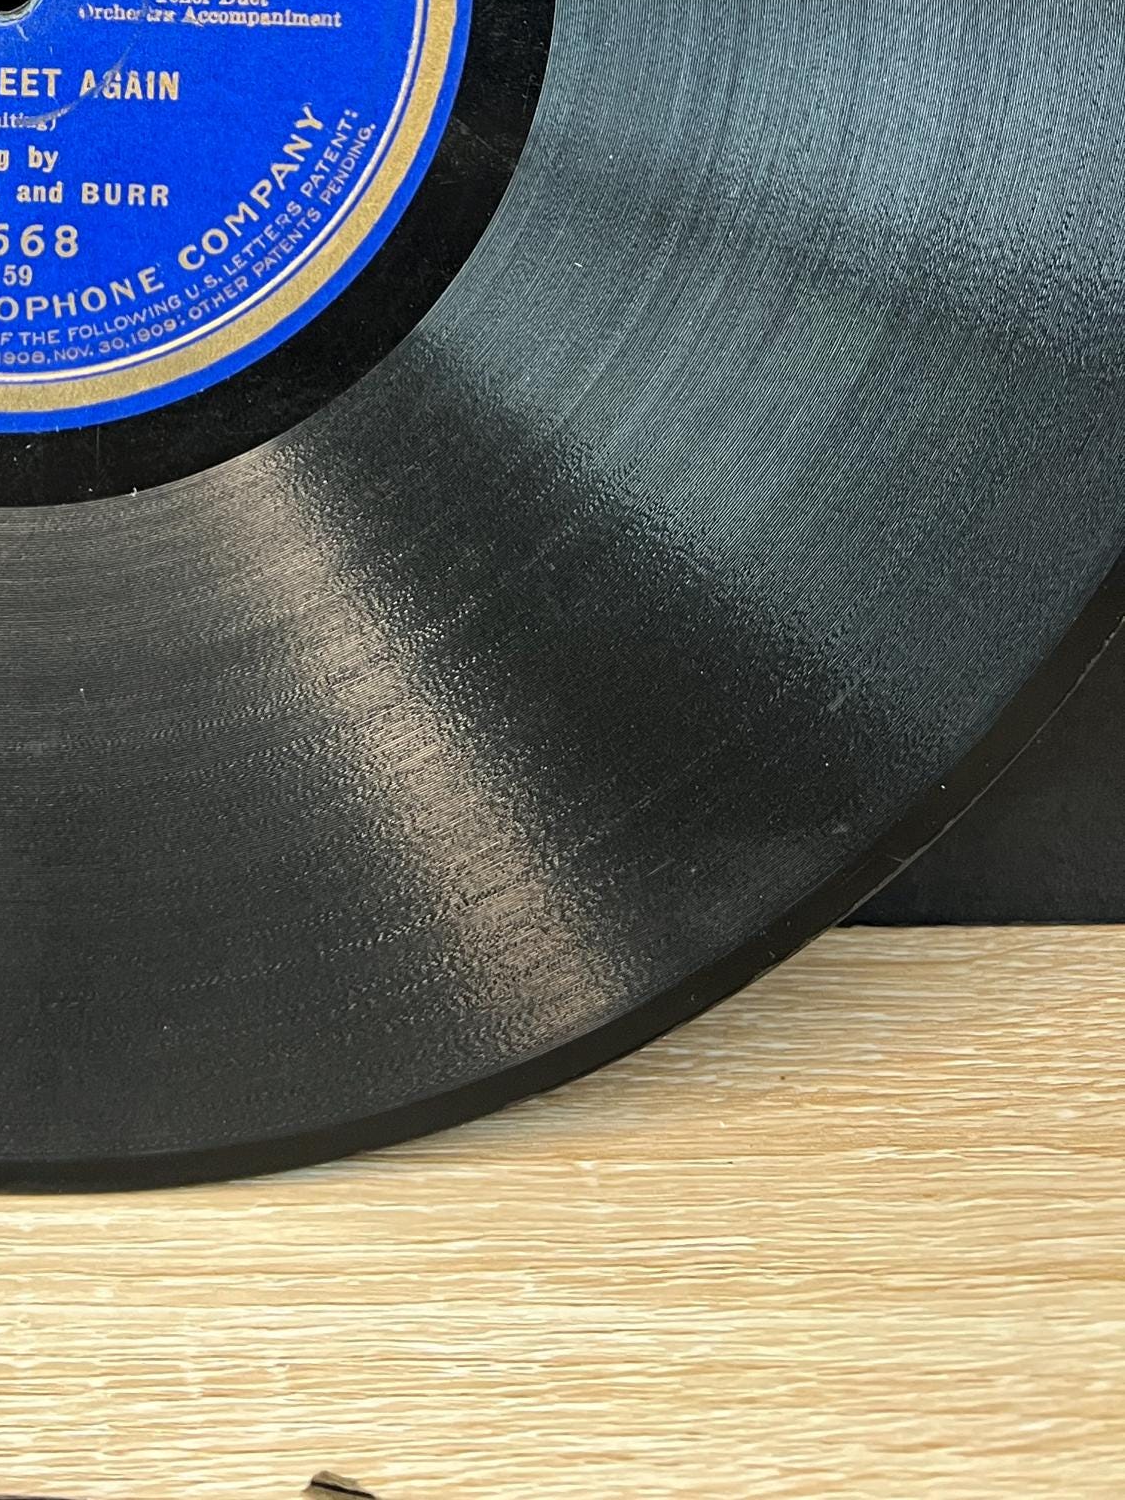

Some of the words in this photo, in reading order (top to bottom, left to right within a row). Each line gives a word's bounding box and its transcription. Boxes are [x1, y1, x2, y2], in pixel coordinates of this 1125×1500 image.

[181, 5, 342, 28] Accompaniment
[78, 69, 180, 100] AGAIN
[28, 145, 60, 173] by
[16, 180, 64, 204] and
[81, 181, 170, 207] BURR
[177, 103, 324, 271] COMPANY
[18, 329, 61, 347] THE
[67, 294, 183, 343] FOLLOWING
[184, 273, 224, 300] U.S.
[221, 200, 303, 277] LETTERS
[299, 108, 358, 198] PATENT:
[53, 344, 94, 361] NOV.
[187, 274, 250, 321] OTHER
[250, 206, 322, 279] PATENTS
[318, 122, 377, 206] PENDING.
